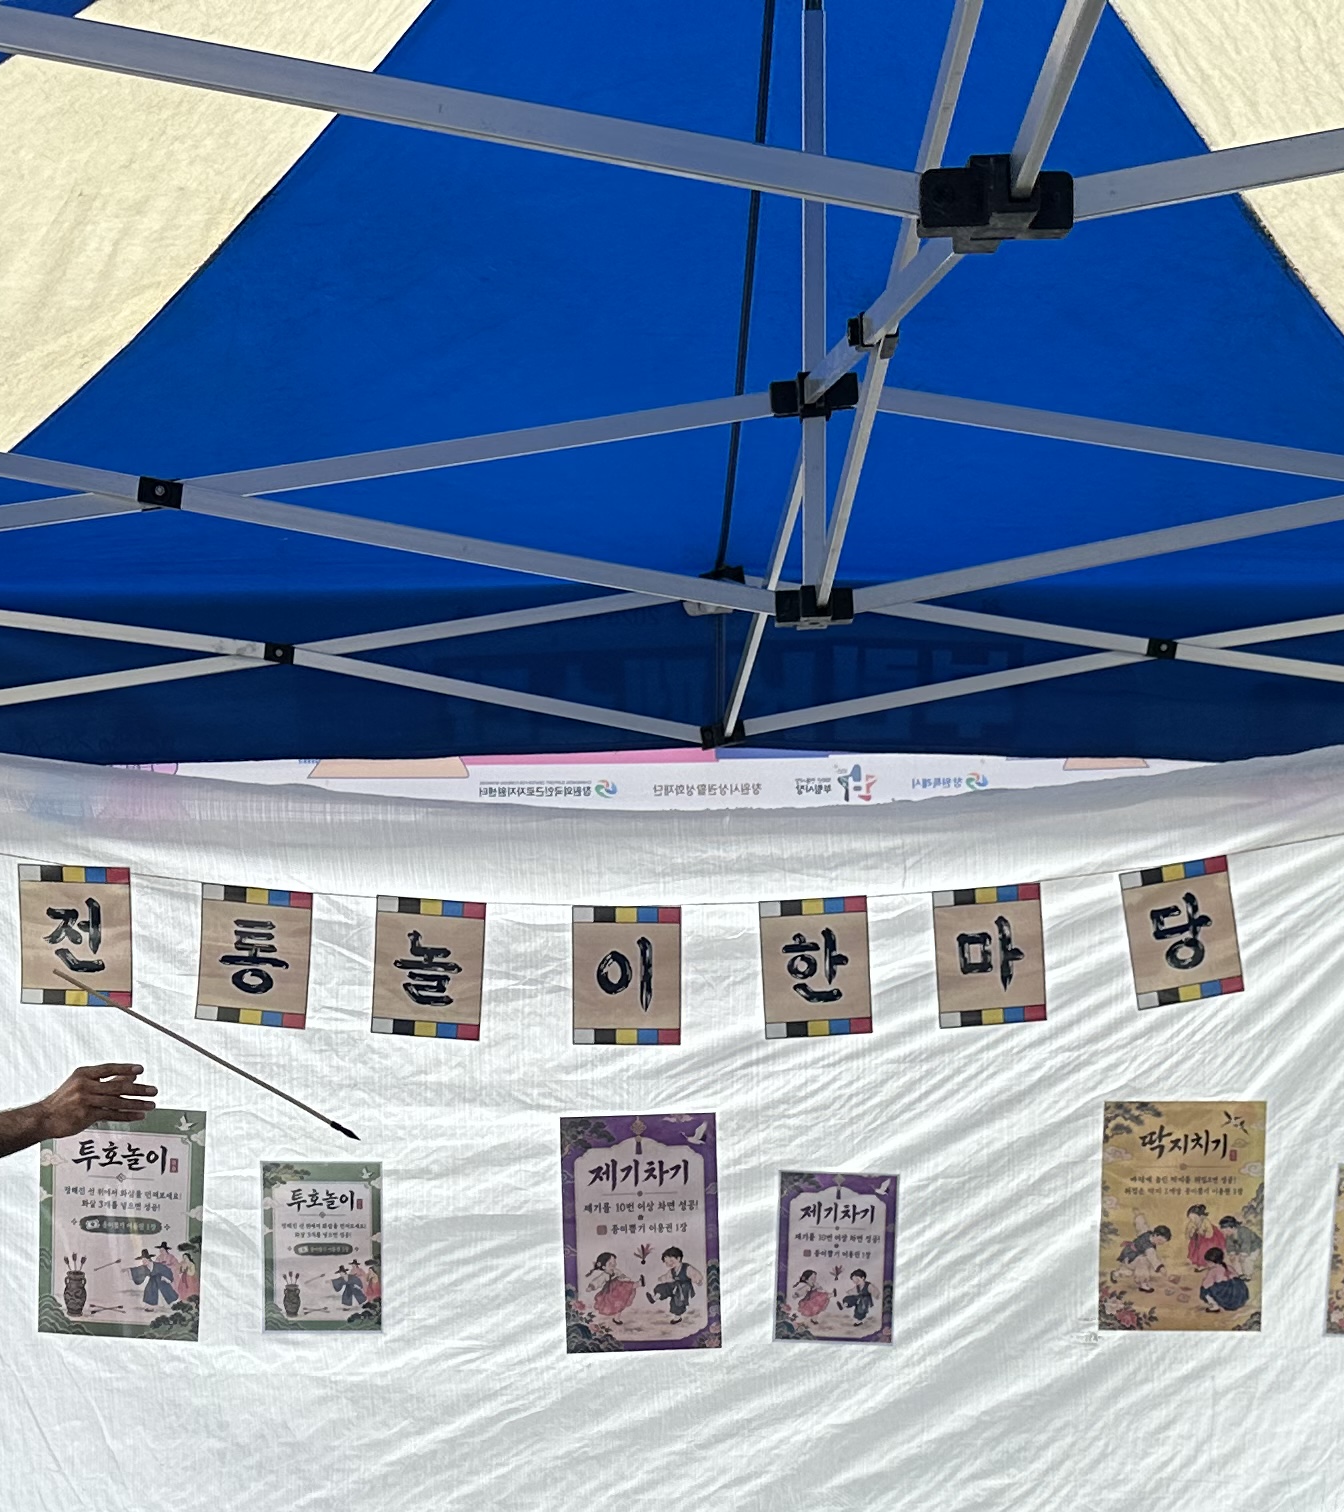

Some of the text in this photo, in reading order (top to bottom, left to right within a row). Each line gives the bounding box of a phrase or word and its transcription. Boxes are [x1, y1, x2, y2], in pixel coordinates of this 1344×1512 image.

[45, 891, 1213, 1012] 전 통 놀 이 한 마 당
[72, 1139, 168, 1175] 투호놀이
[1138, 1124, 1228, 1160] 딱지치기
[587, 1159, 689, 1192] 제기차기
[286, 1188, 355, 1213] 투호놀이
[582, 1201, 611, 1214] 제기를
[615, 1201, 635, 1213] 10번
[678, 1199, 699, 1212] 성공!
[799, 1201, 875, 1226] 제기차기
